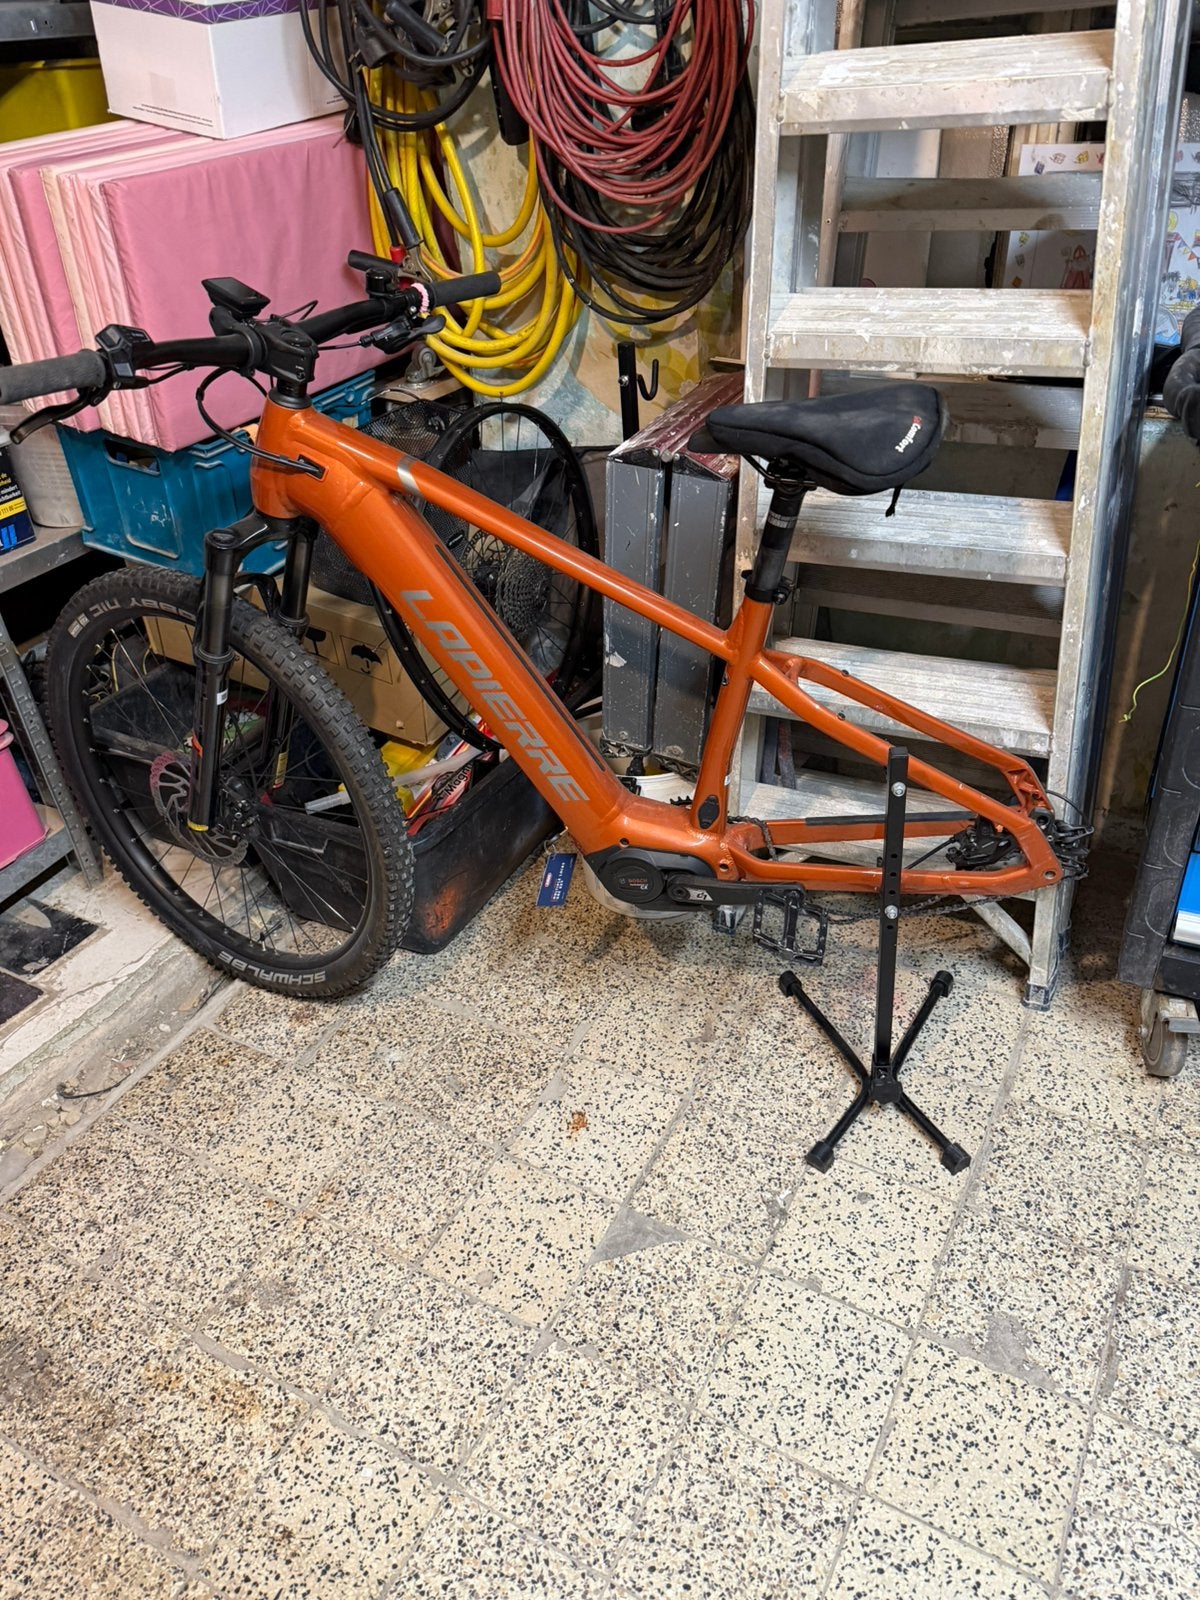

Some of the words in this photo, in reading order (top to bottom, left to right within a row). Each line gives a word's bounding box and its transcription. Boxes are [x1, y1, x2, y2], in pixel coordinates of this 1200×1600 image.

[894, 422, 922, 454] Comfort
[400, 590, 590, 802] LAPIERRE
[217, 950, 327, 986] SCHWALBE
